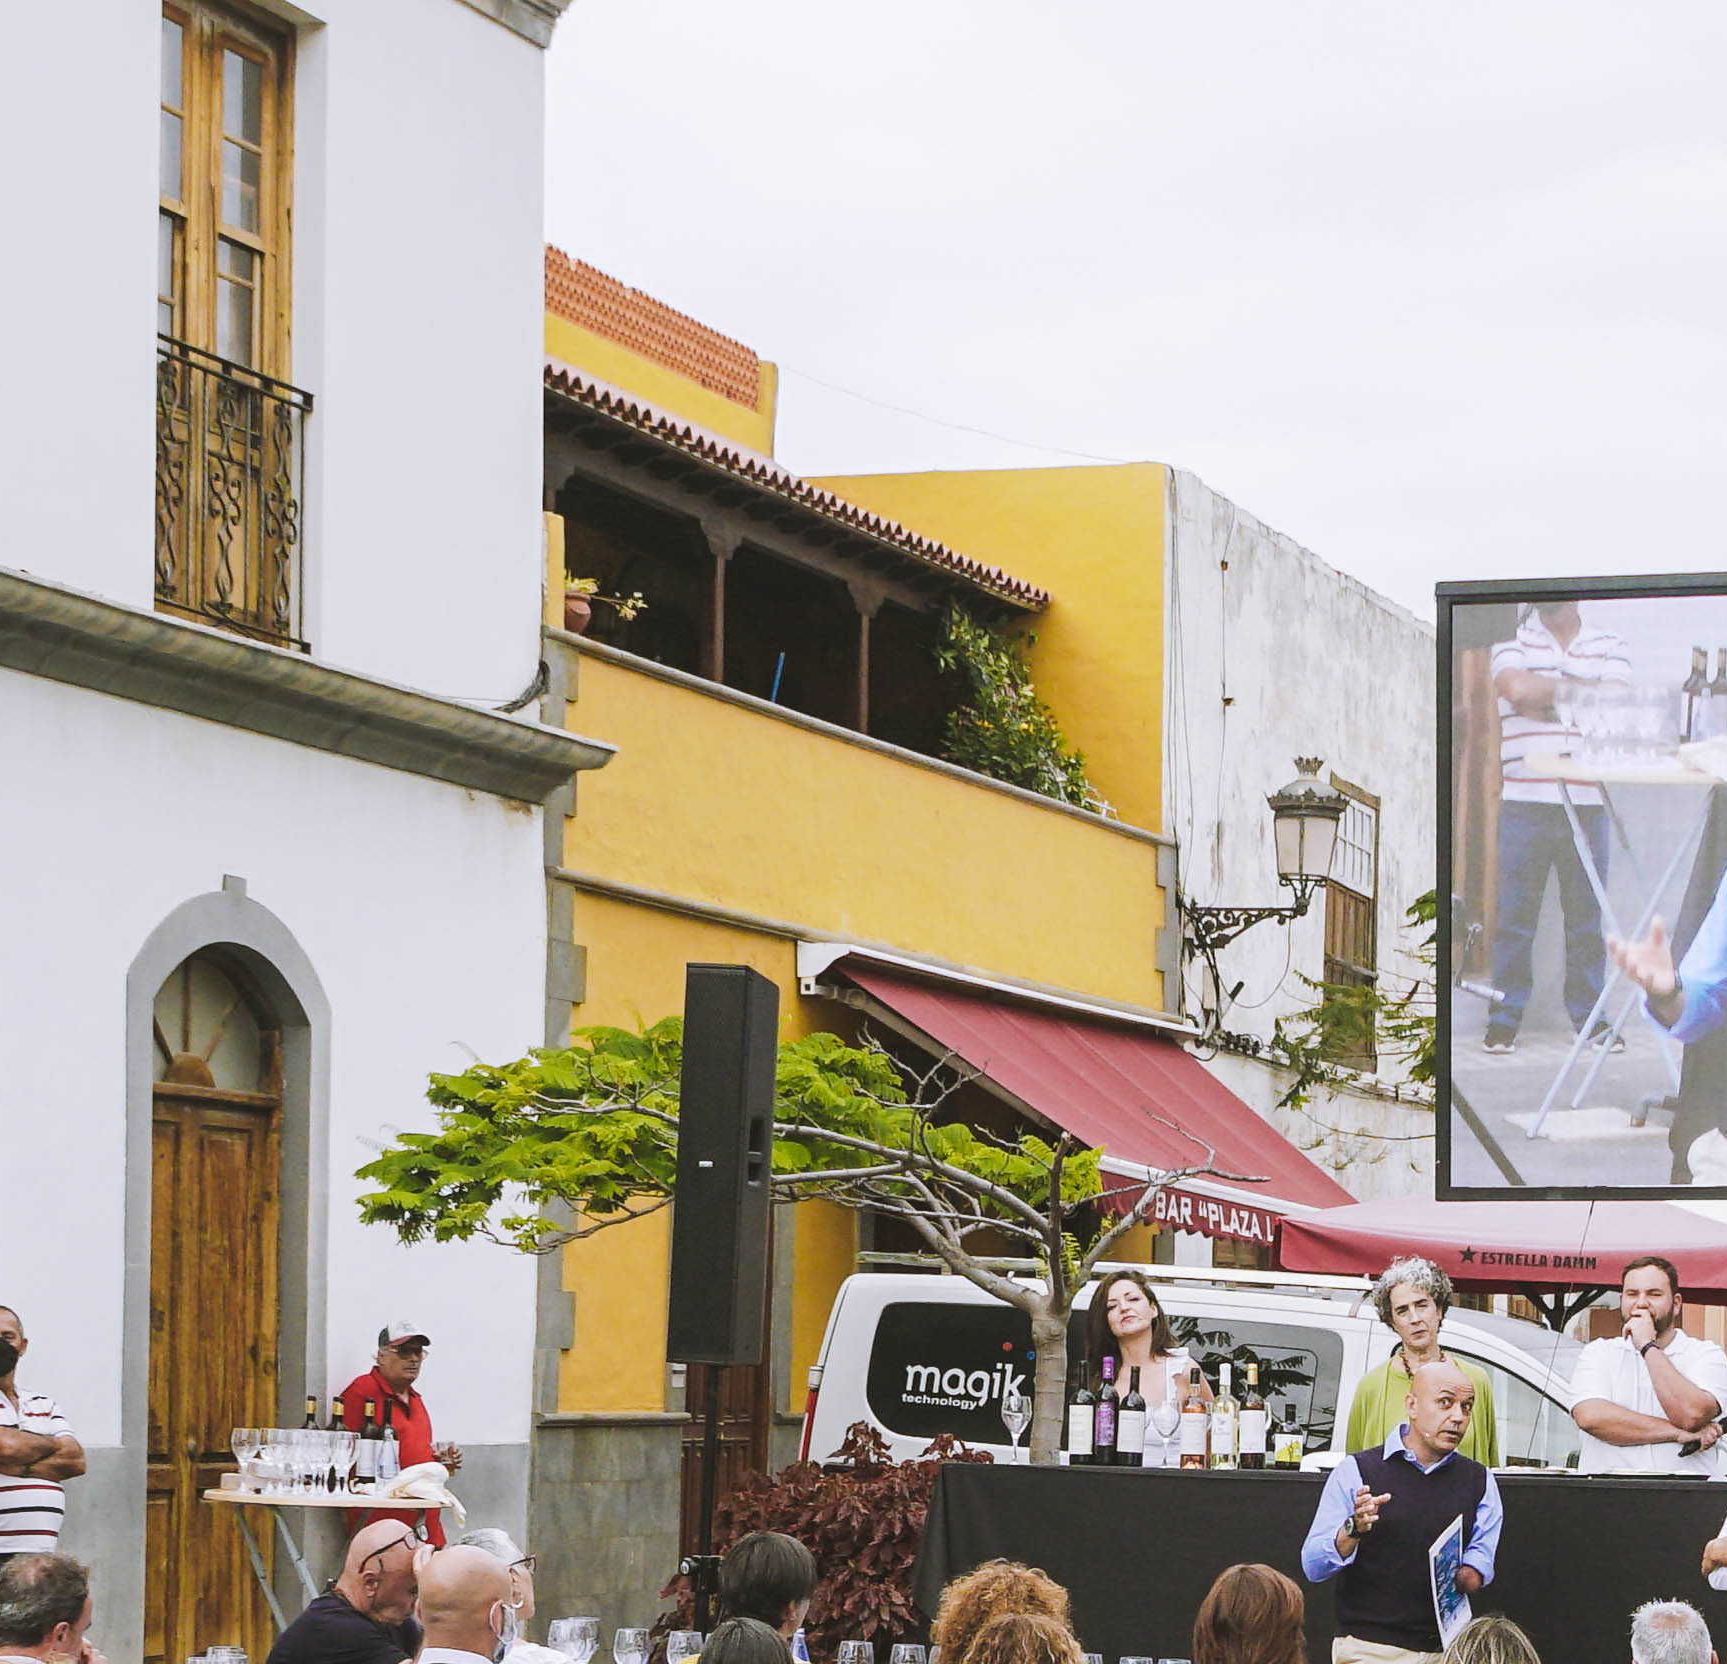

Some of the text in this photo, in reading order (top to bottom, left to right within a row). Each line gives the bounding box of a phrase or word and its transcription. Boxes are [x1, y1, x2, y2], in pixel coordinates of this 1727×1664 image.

[1155, 1191, 1194, 1226] BAR
[1480, 1252, 1597, 1270] ESTRELLA DAMM
[906, 1363, 1026, 1407] magik
[901, 1392, 977, 1411] technology
